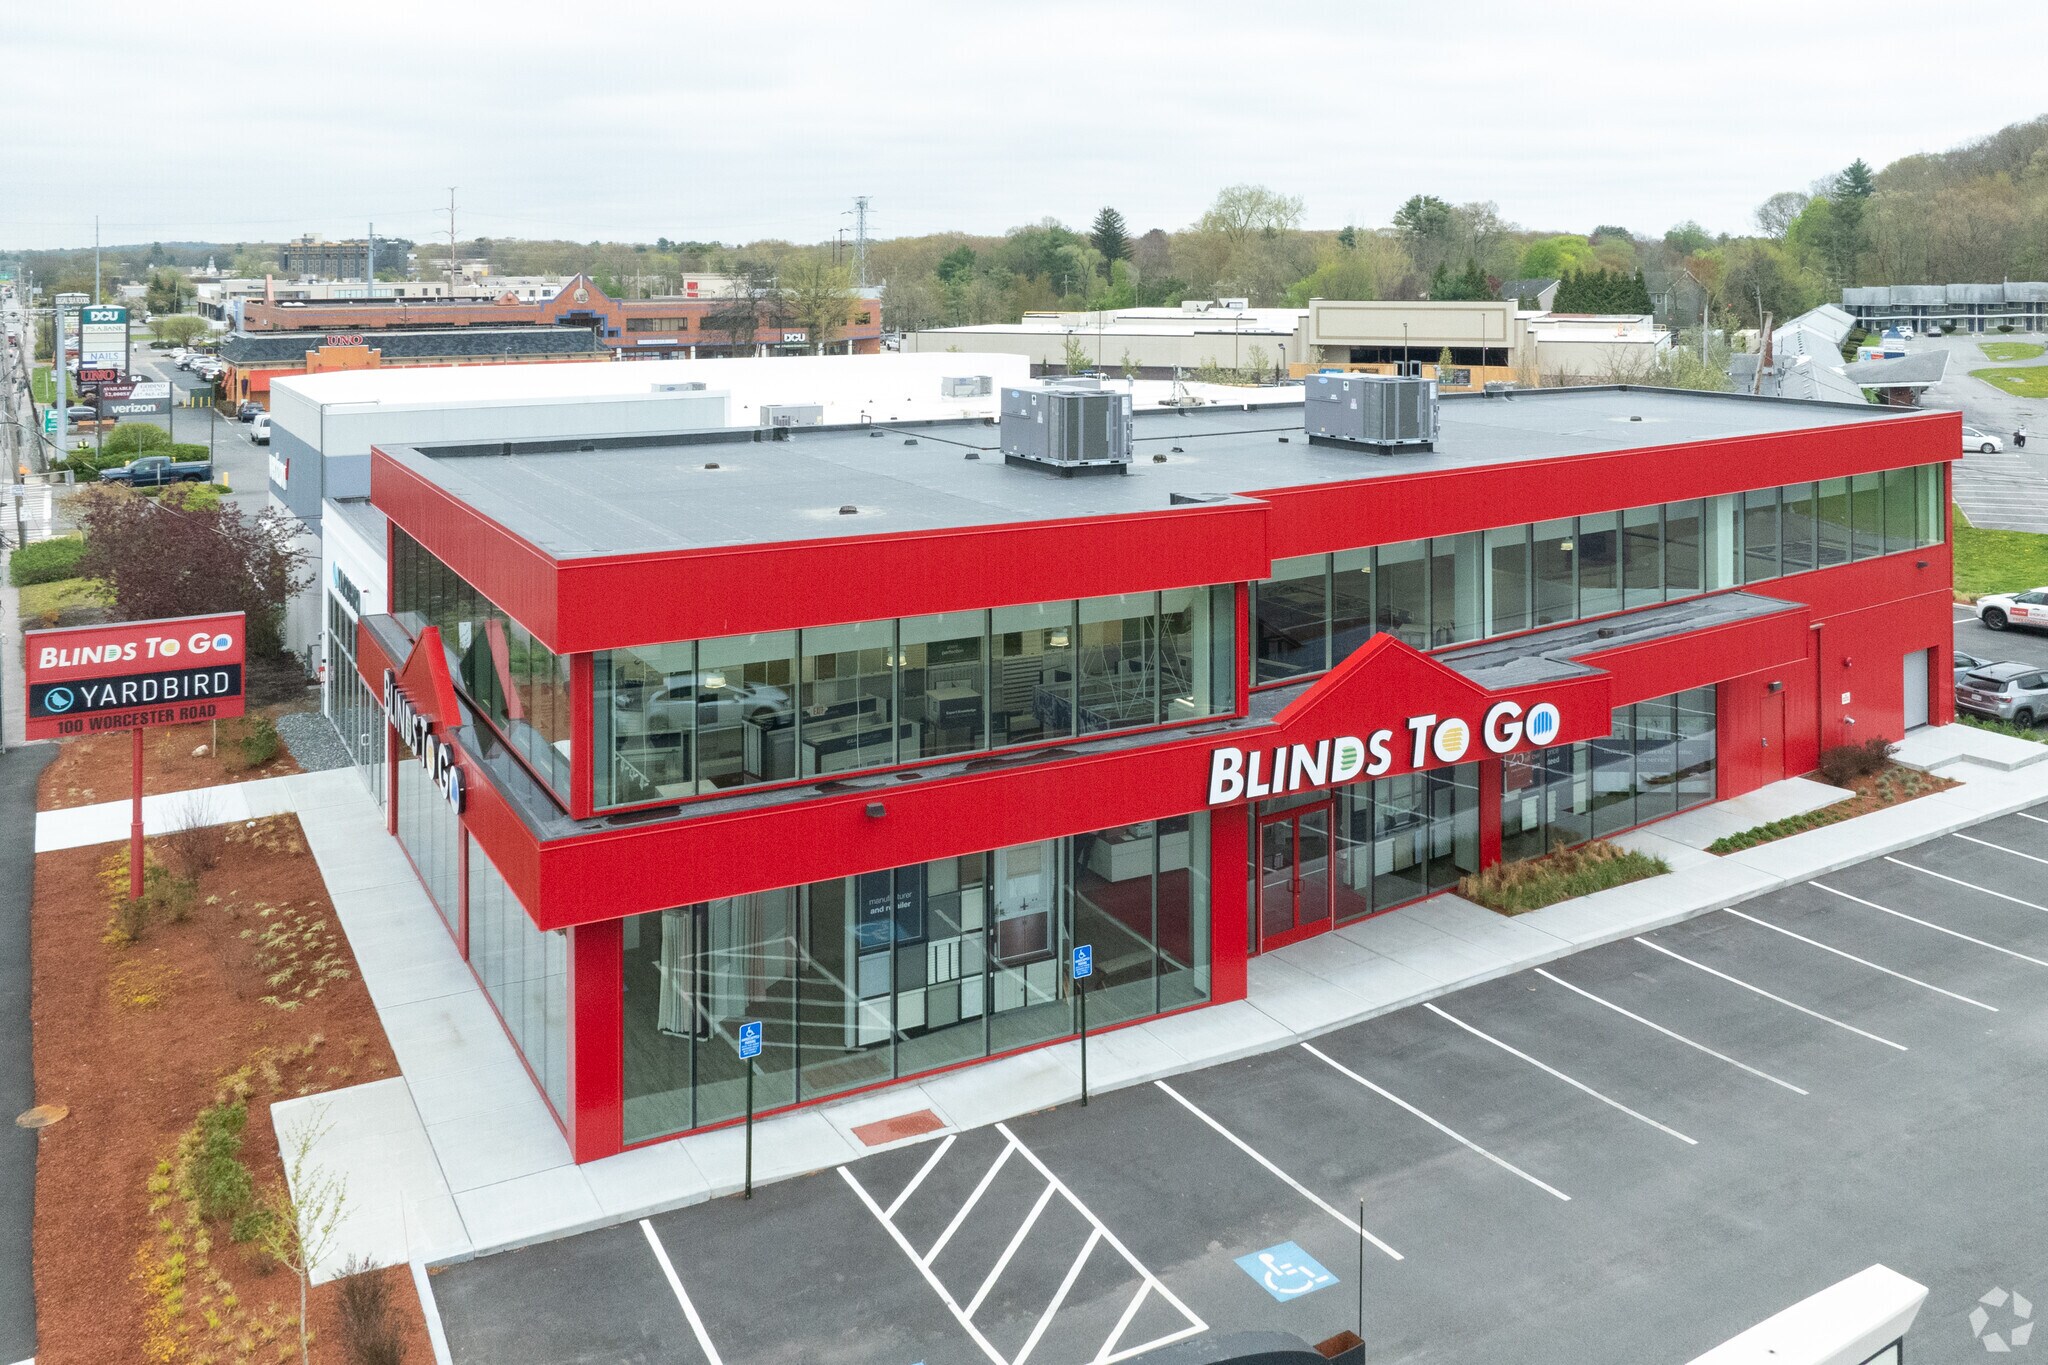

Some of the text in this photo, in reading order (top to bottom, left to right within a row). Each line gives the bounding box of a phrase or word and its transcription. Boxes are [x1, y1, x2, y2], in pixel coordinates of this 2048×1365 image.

[90, 311, 119, 321] DCU
[327, 335, 363, 346] UNO
[783, 333, 806, 342] DCU
[90, 352, 119, 360] NAILS
[80, 370, 115, 381] UNO
[111, 403, 156, 413] verizon
[39, 632, 233, 669] BLINDS TO GO
[81, 671, 229, 708] YARDBIRD
[57, 704, 216, 734] 100 WORCESTER ROAD
[384, 668, 462, 815] BLINDS TO GO
[1208, 700, 1561, 806] BLINDS TO GO
[870, 905, 884, 915] and
